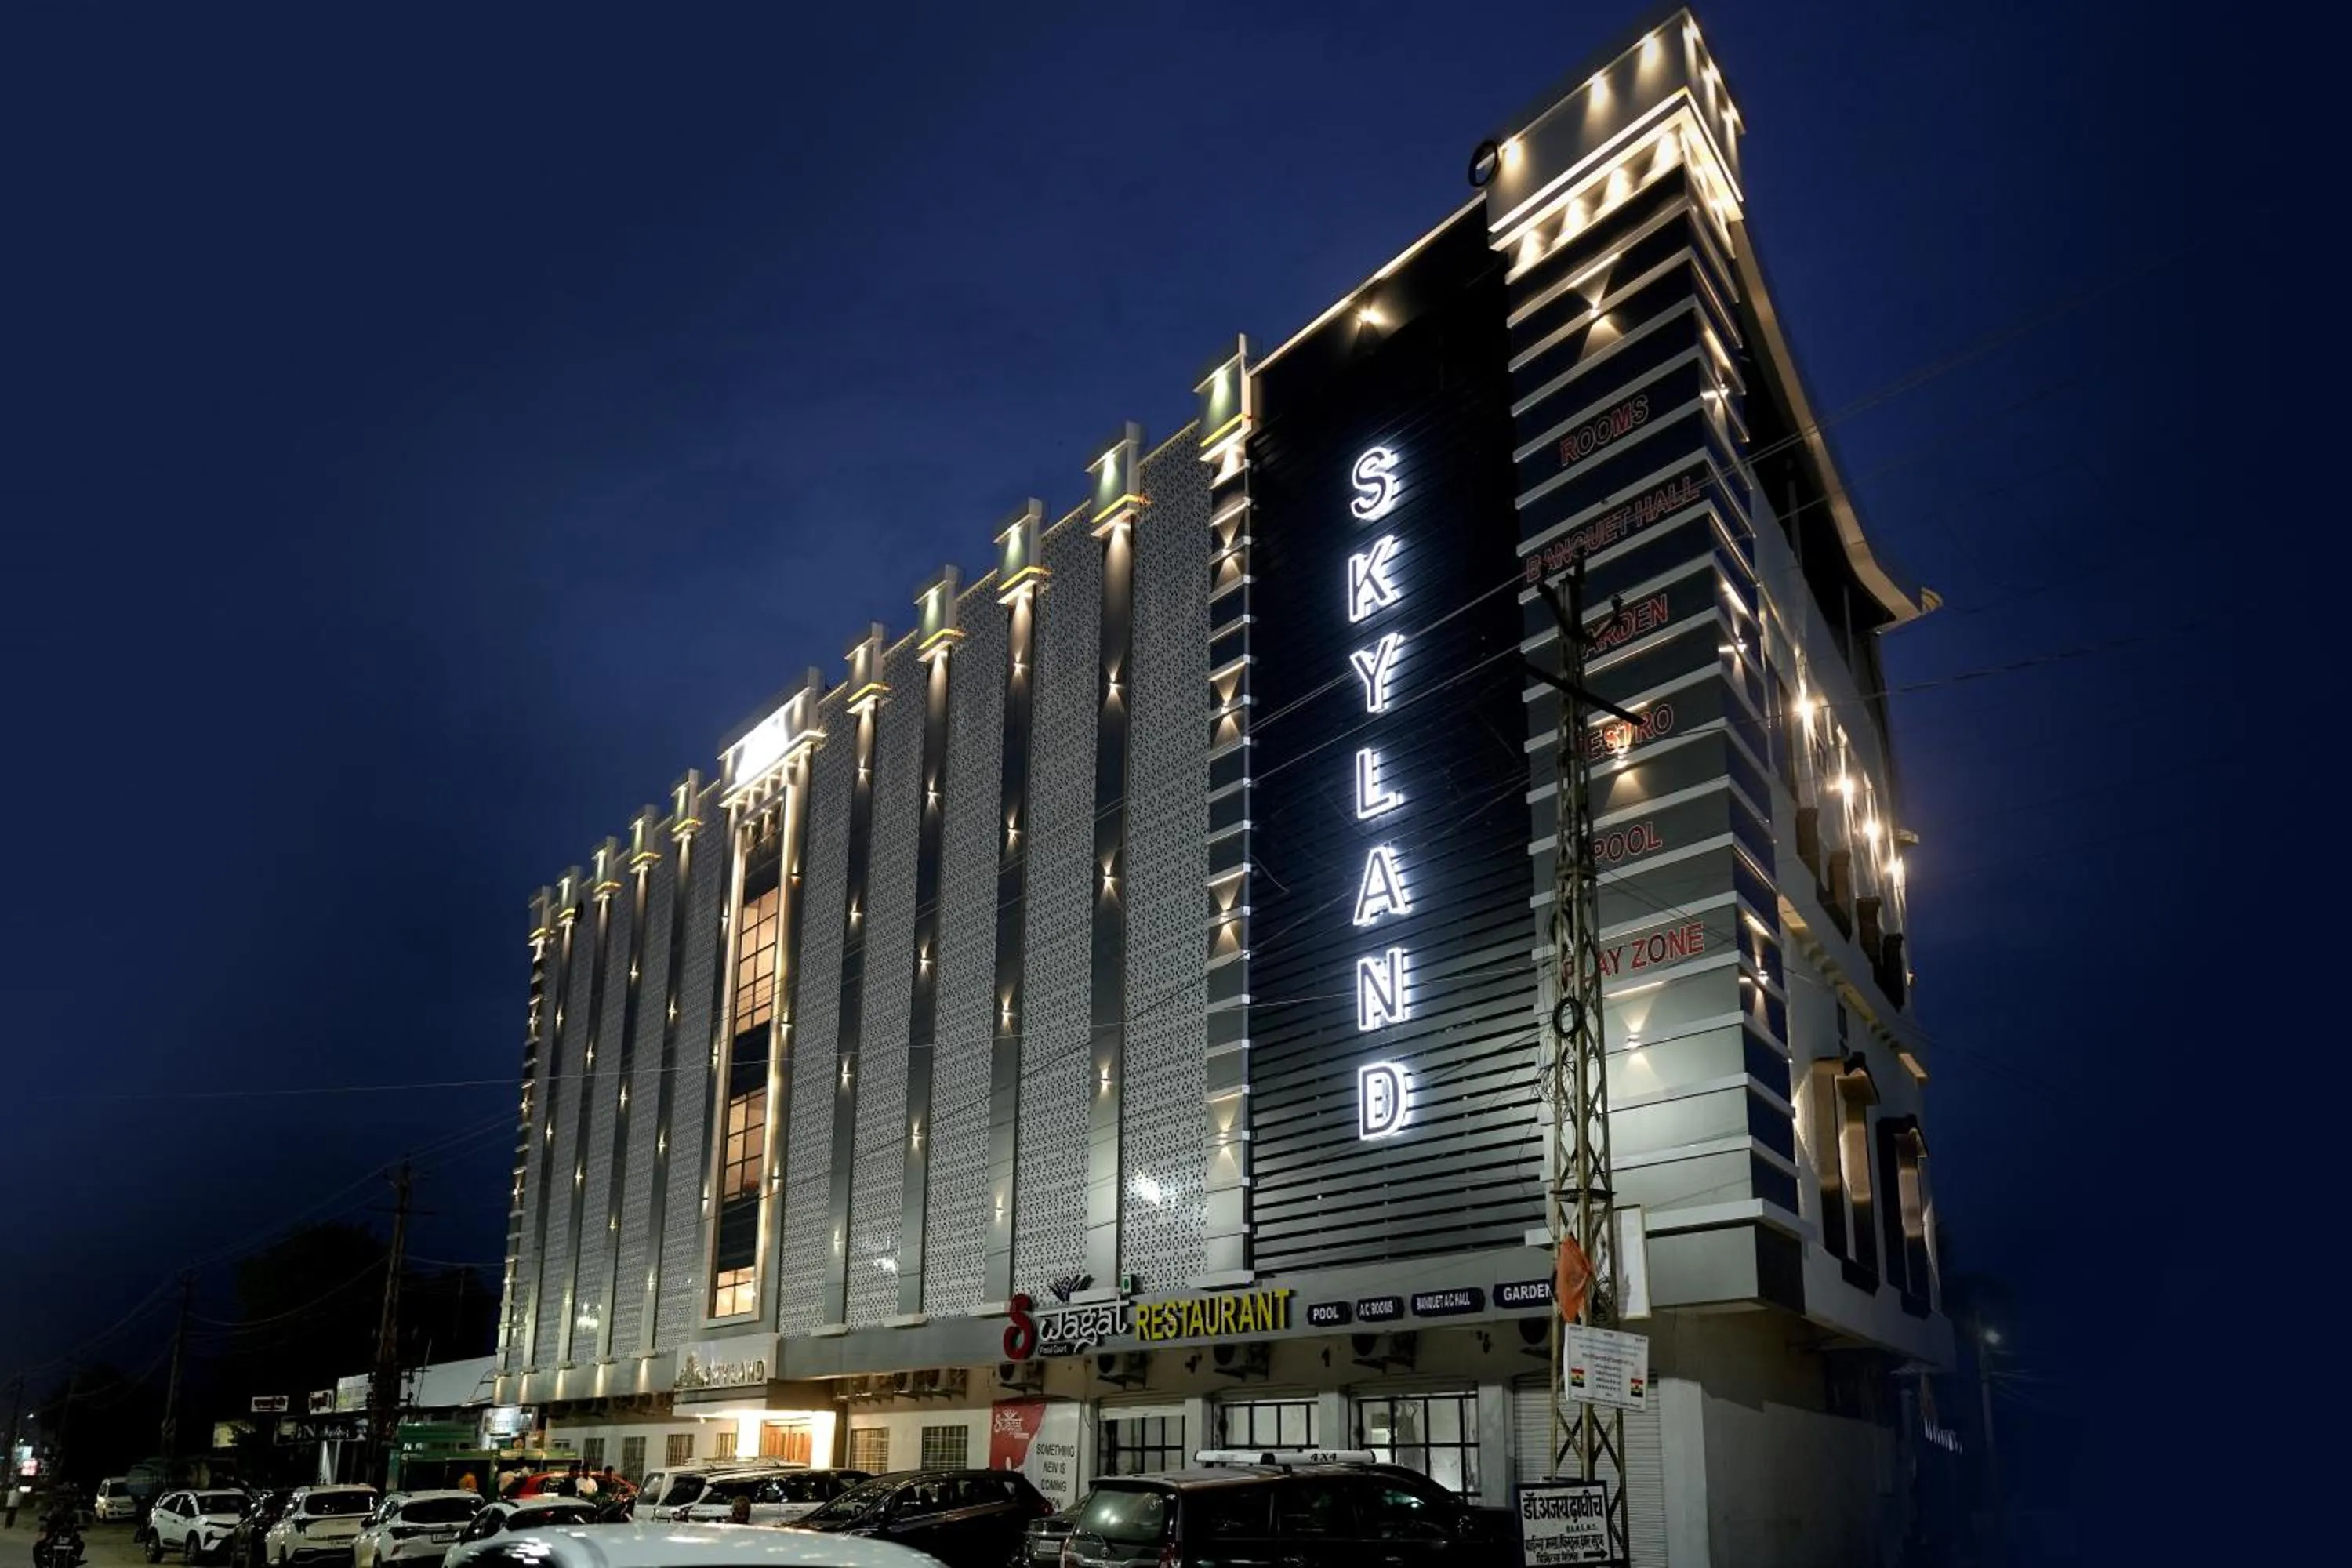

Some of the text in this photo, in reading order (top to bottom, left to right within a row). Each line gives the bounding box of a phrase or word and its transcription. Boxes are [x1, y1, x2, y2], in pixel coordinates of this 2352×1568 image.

[1561, 394, 1650, 466] ROOMS
[1634, 475, 1701, 527] HALL
[1347, 445, 1417, 1145] SKYLAND
[1593, 822, 1662, 862] POOL
[1631, 922, 1704, 971] ZONE
[1136, 1289, 1290, 1341] RESTAURANT
[1313, 1305, 1340, 1321] POOL
[1036, 1443, 1075, 1457] SOMETHING
[1040, 1478, 1067, 1492] COMING
